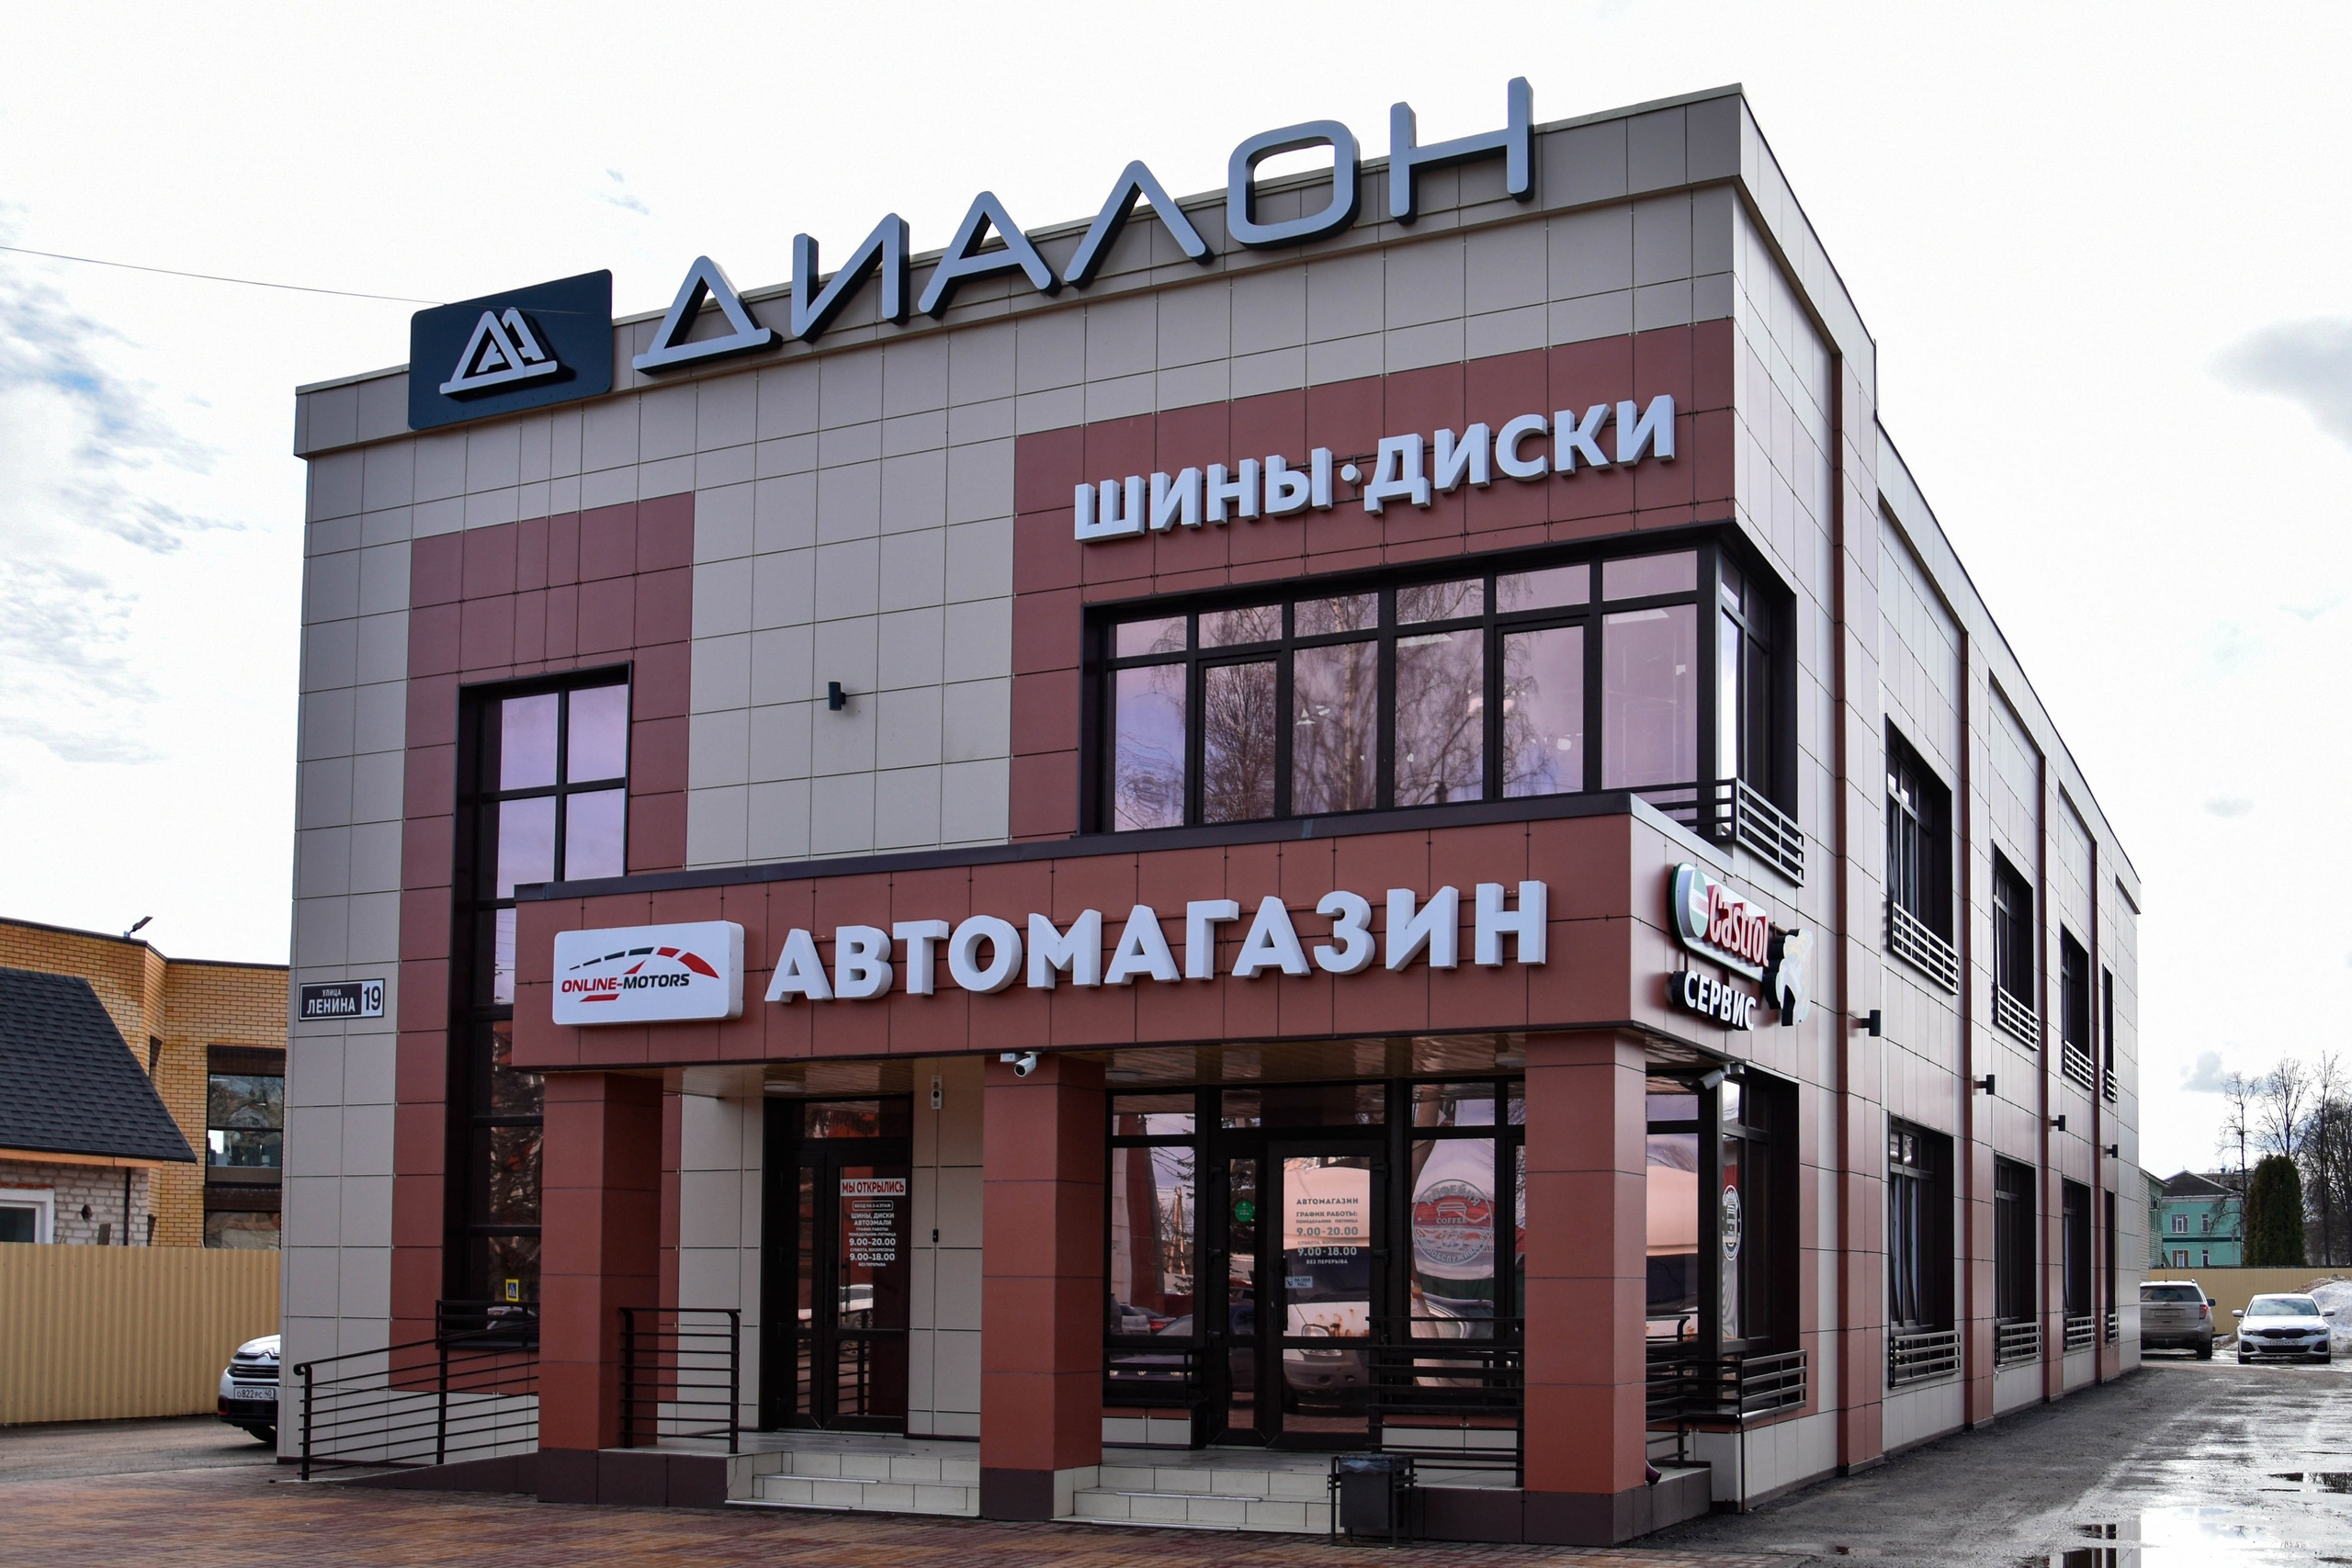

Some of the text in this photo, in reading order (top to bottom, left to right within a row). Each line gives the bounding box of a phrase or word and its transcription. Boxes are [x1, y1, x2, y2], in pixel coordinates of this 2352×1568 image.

[632, 76, 1535, 375] ДИАЛОН
[1074, 394, 1676, 544] ШИНЫ ДИСКИ
[1709, 884, 1770, 968] Castrol
[764, 879, 1547, 1002] АВТОМАГАЗИН
[322, 987, 342, 998] УЛИЦА
[561, 973, 690, 993] ONLINE-MOTORS
[307, 997, 356, 1015] ЛЕНИНА
[363, 985, 381, 1011] 19
[1683, 970, 1757, 1032] СЕРВИС
[842, 1181, 905, 1193] МЫ ОТКРЫЛИСЬ
[1425, 1184, 1481, 1206] КОФЕЙНЯ
[849, 1237, 896, 1246] 9.00-20.00
[850, 1253, 896, 1261] 9.00-18.00
